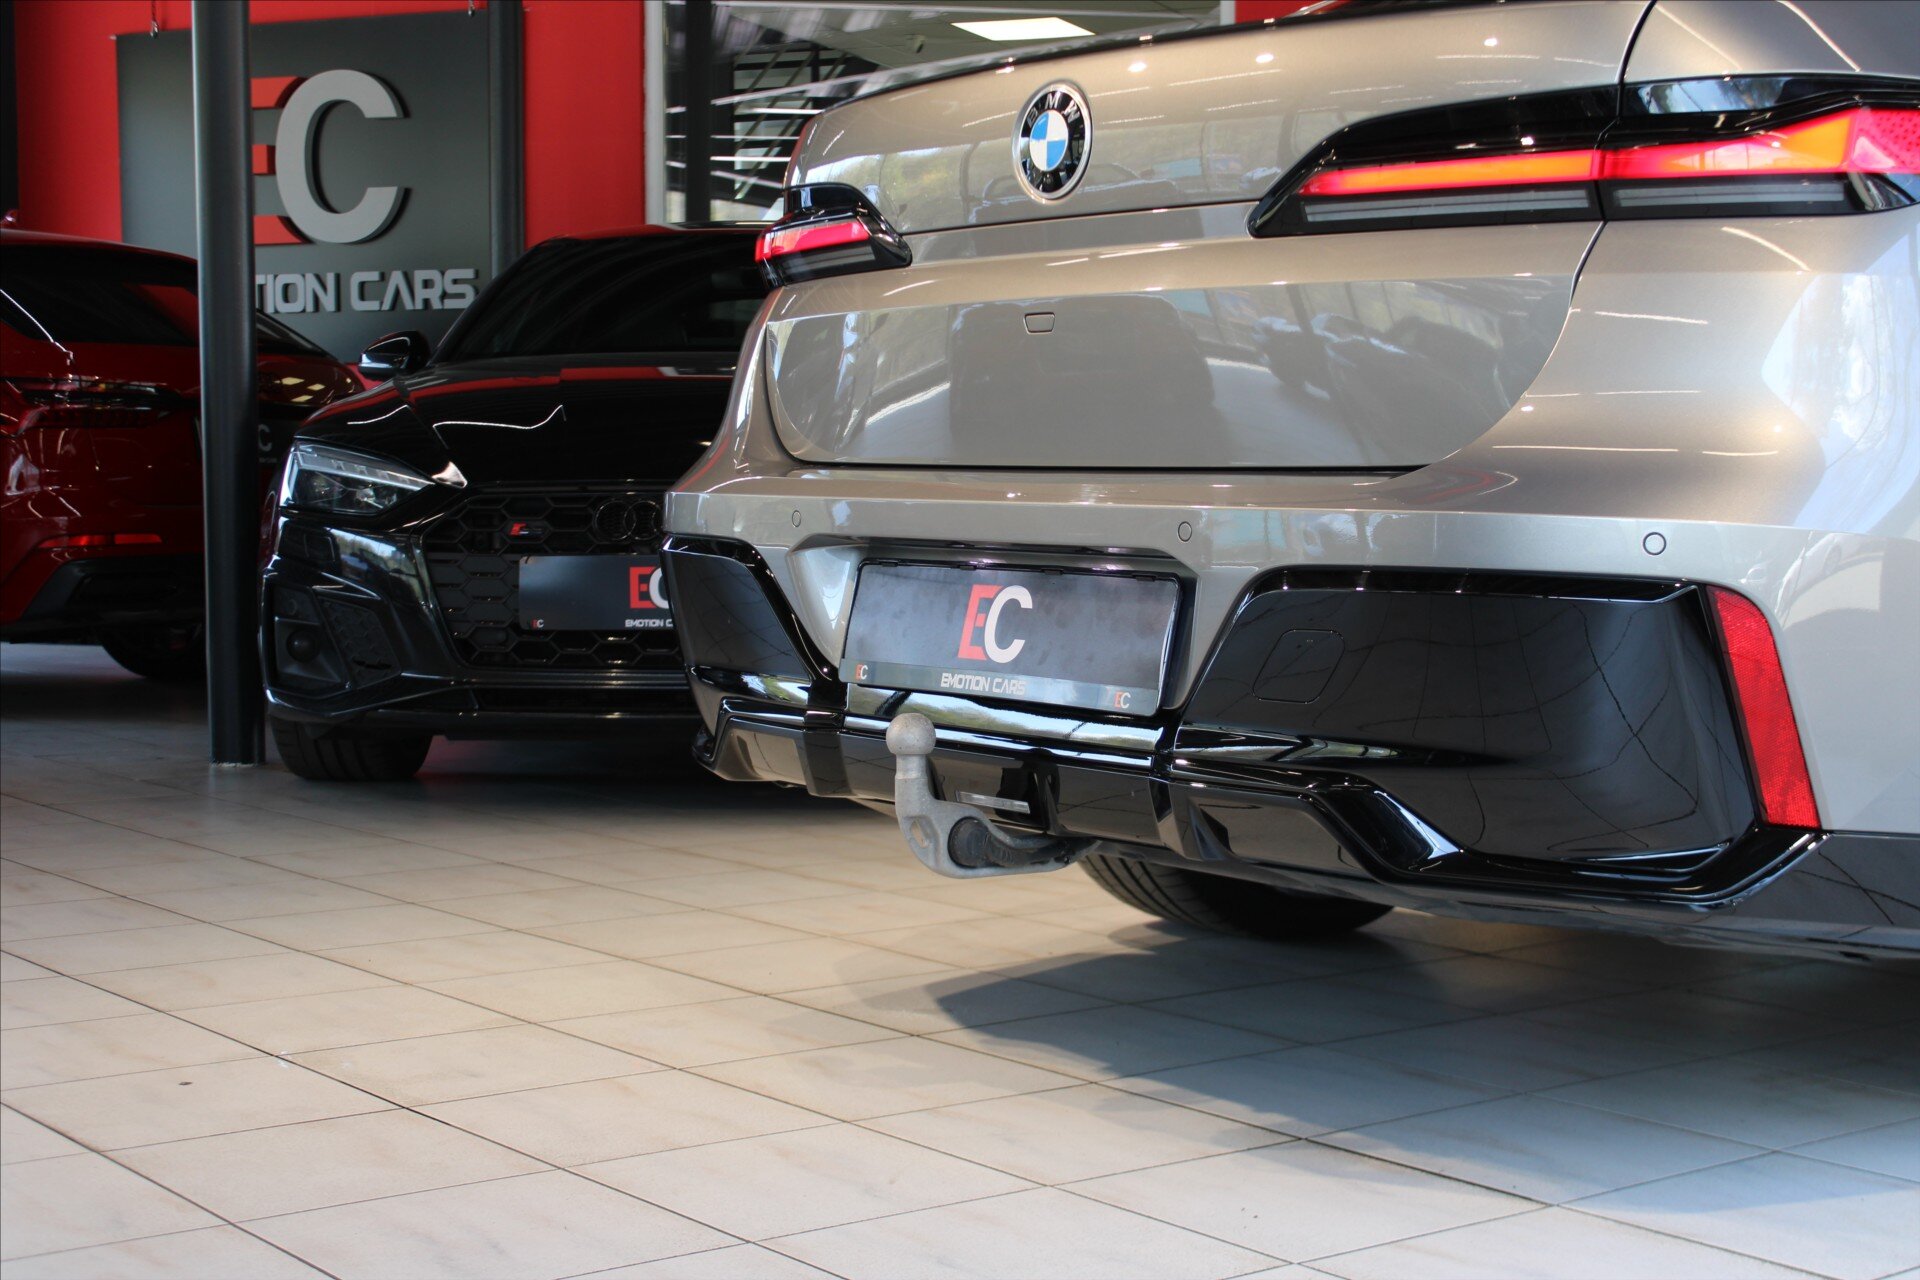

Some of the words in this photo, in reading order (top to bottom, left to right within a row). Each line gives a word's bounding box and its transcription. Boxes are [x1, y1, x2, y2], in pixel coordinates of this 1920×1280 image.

[1027, 92, 1081, 128] BMW
[351, 268, 477, 312] CARS
[625, 618, 664, 628] EMOTION
[957, 583, 1033, 664] EC
[855, 664, 868, 680] EC
[940, 672, 991, 693] EMOTION
[992, 678, 1027, 696] CARS
[1114, 691, 1131, 709] EC
